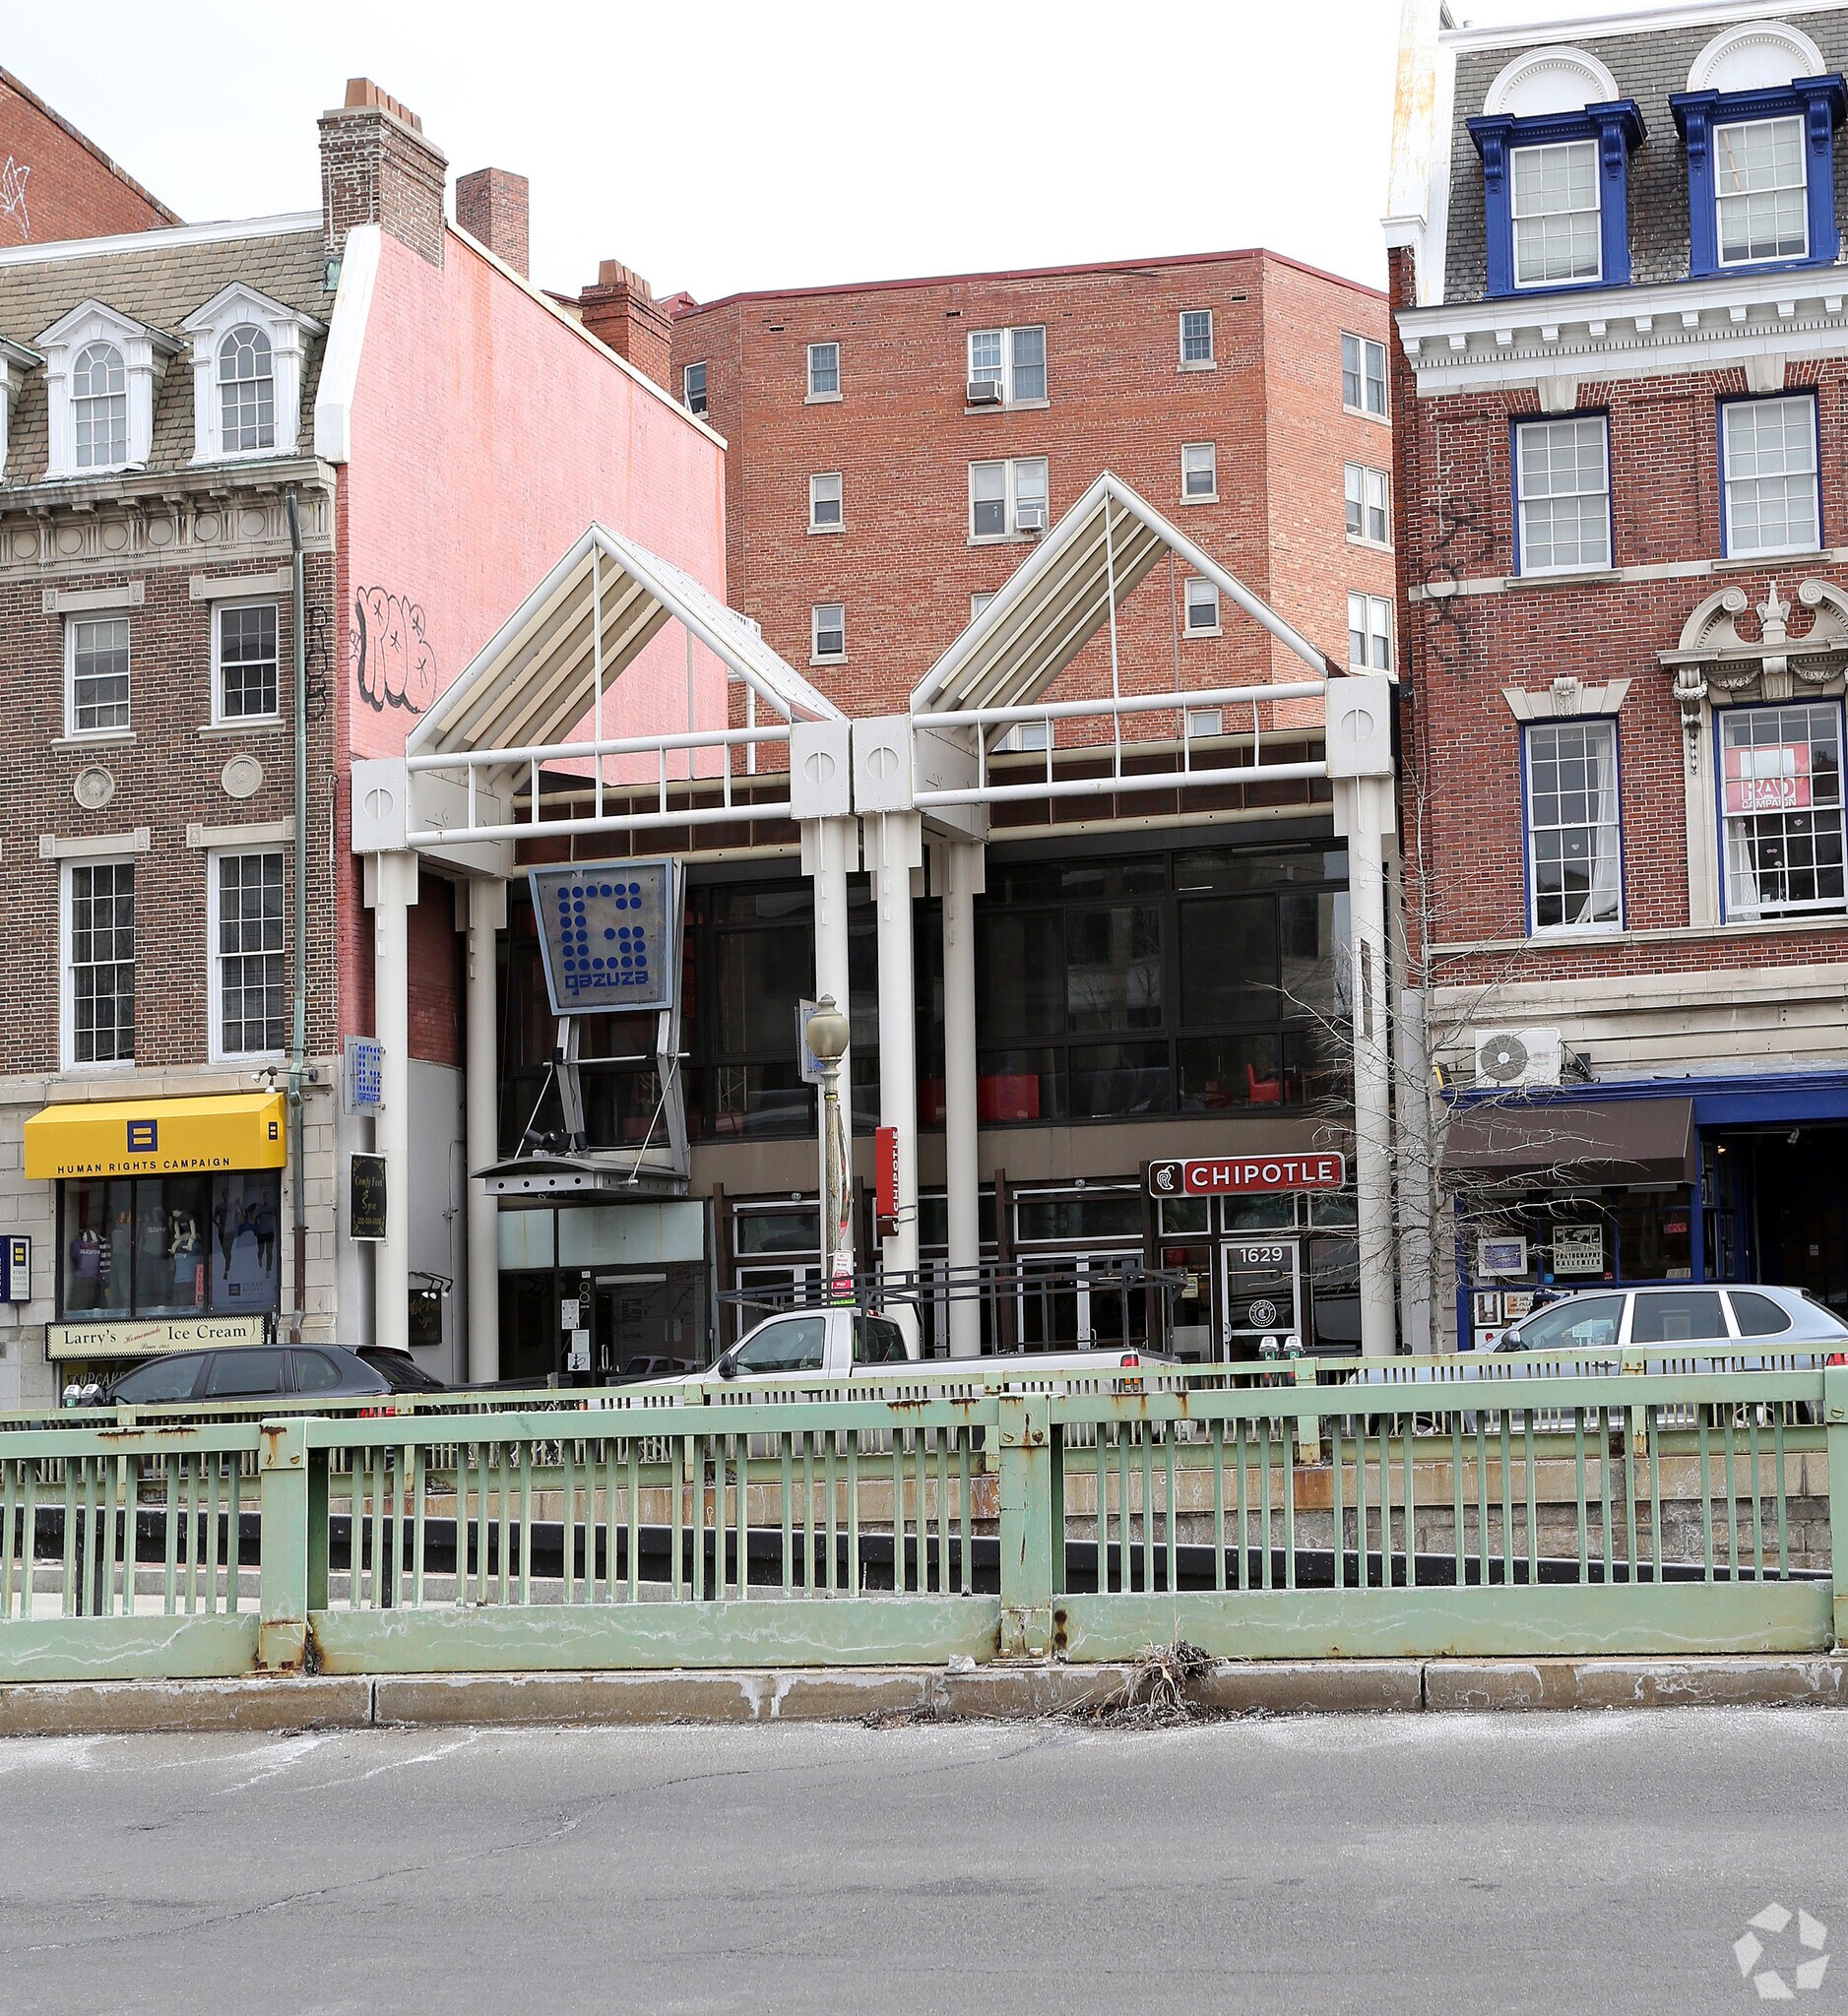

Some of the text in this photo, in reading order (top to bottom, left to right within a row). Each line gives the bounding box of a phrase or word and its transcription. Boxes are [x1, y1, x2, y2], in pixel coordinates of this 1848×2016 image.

[1741, 777, 1797, 801] RAD
[557, 882, 647, 973] G
[564, 970, 650, 996] gazuza
[57, 1157, 231, 1174] HUMAN RIGHTS CAMPAIGN
[1191, 1161, 1333, 1187] CHIPOTLE
[1240, 1247, 1283, 1263] 1629
[64, 1329, 116, 1346] Larry's
[167, 1325, 190, 1340] Ice
[197, 1324, 247, 1339] Cream
